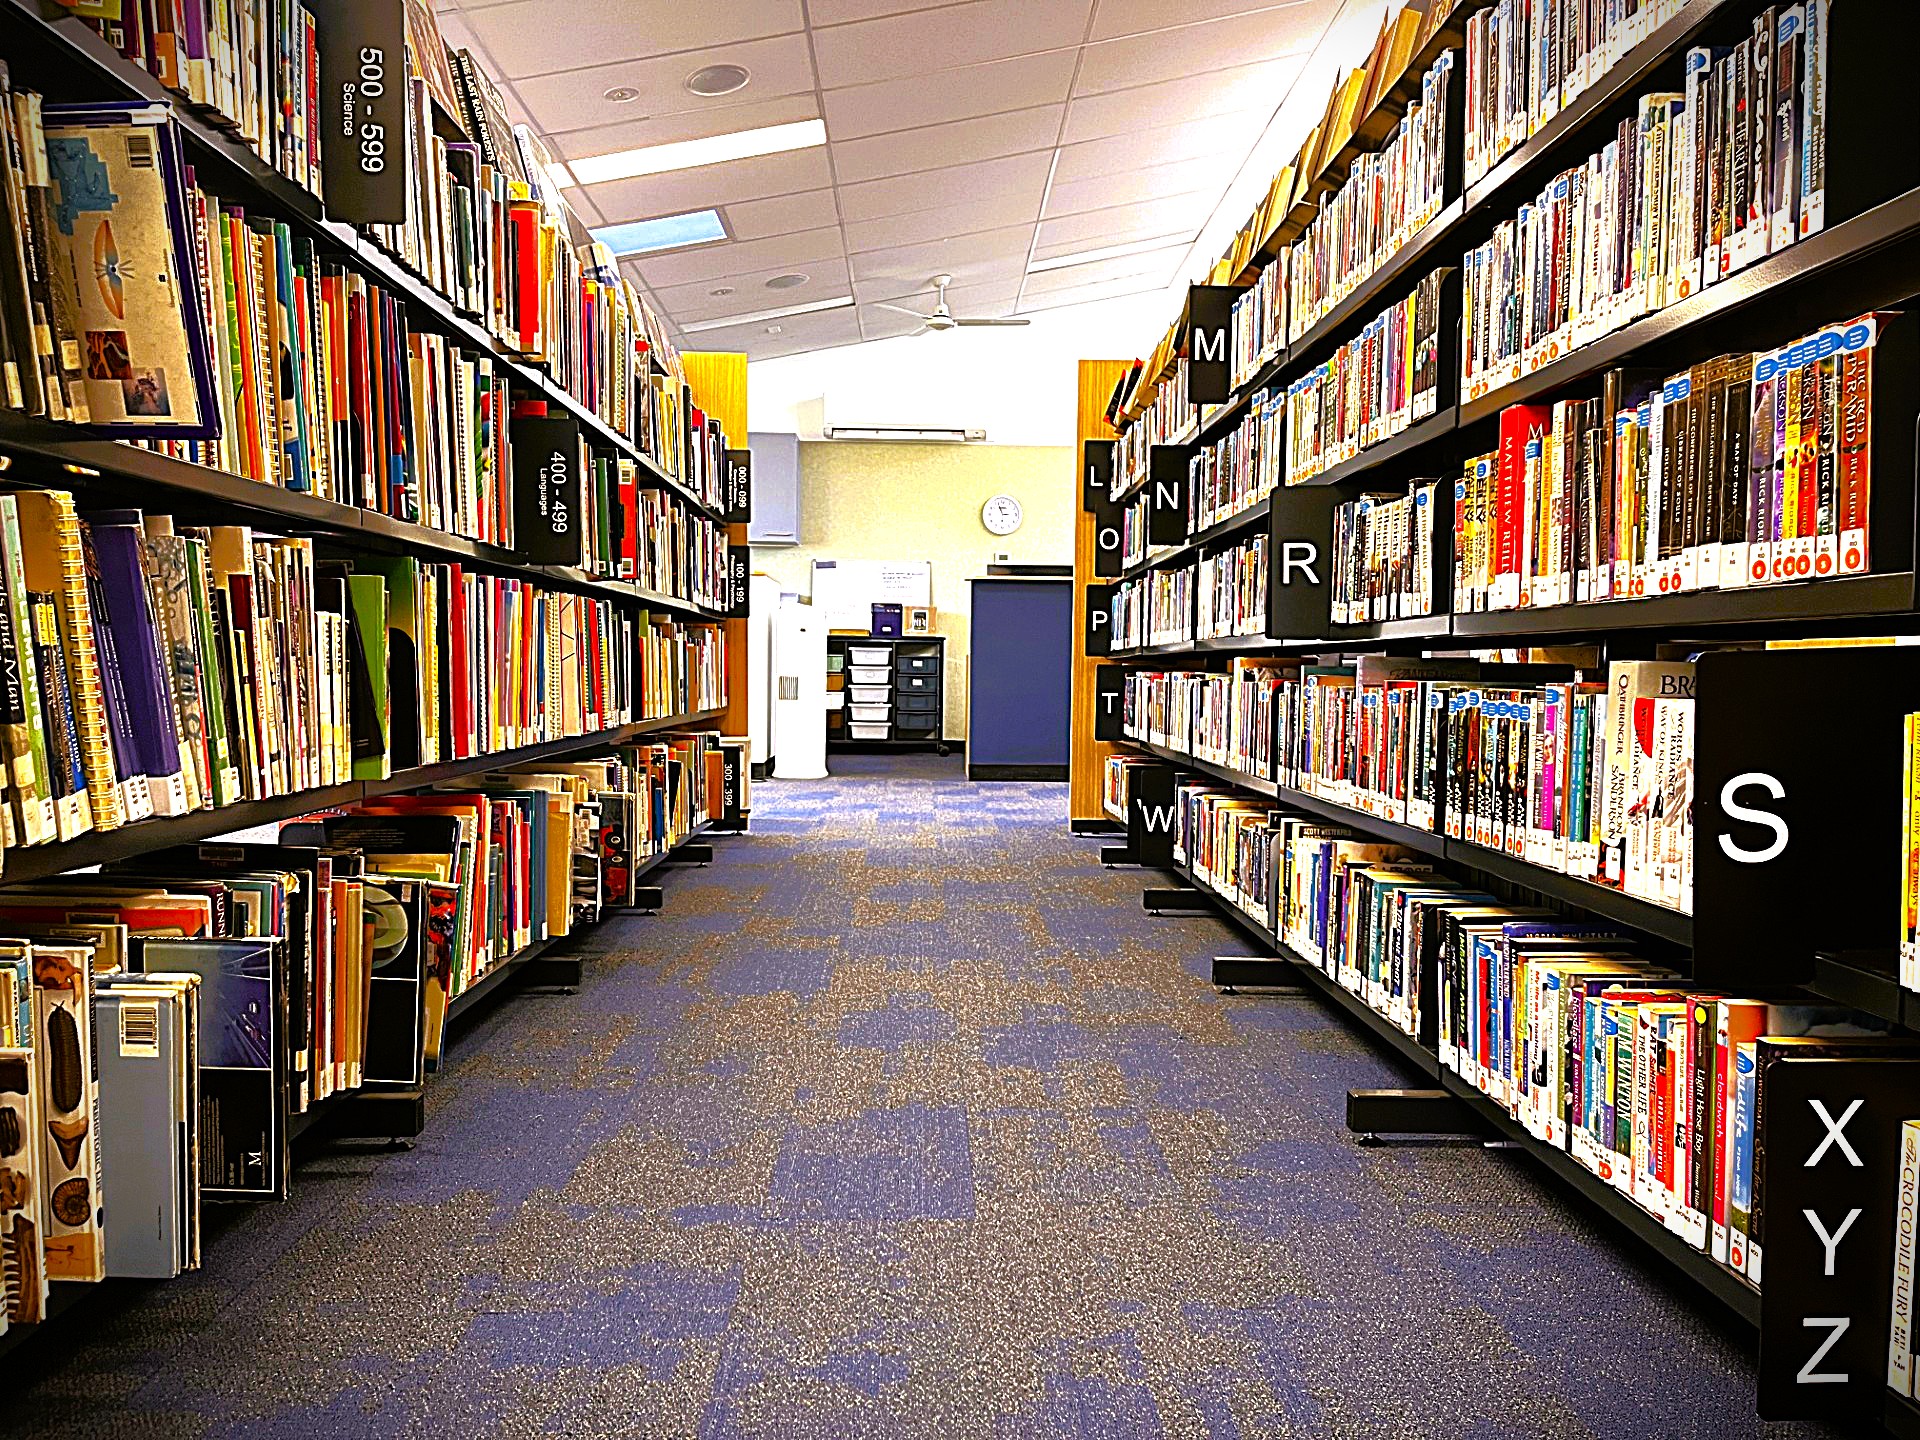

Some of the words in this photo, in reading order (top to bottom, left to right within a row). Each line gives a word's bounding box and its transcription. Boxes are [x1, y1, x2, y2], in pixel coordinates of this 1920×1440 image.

[360, 47, 384, 97] 500
[343, 82, 356, 136] Science
[366, 104, 372, 116] -
[460, 55, 470, 77] THE
[465, 76, 479, 98] LAST
[472, 97, 484, 122] RAIN
[478, 123, 496, 162] FORESTS
[361, 123, 384, 173] 599
[1735, 119, 1749, 206] HEARTLESS
[1651, 189, 1660, 220] SNOWY
[1194, 328, 1225, 362] M
[1821, 374, 1834, 436] JACKSON
[1844, 356, 1859, 443] PYRAMID
[1855, 399, 1866, 434] RED
[551, 451, 567, 485] 400
[1676, 430, 1685, 471] LIBRARY
[1688, 425, 1696, 481] CONFERENCE
[738, 466, 747, 484] 000
[1090, 465, 1104, 487] L
[1503, 436, 1513, 525] MATTHEW
[1676, 474, 1682, 488] OF
[1733, 464, 1739, 478] OF
[1821, 458, 1830, 489] RICK
[538, 467, 548, 516] Languages
[555, 488, 560, 497] -
[738, 490, 747, 508] 099
[1156, 481, 1179, 510] N
[552, 500, 568, 533] 499
[1579, 497, 1590, 562] KINGDOMS
[1099, 527, 1120, 550] O
[736, 562, 745, 578] 100
[1282, 542, 1320, 584] R
[736, 586, 745, 603] 199
[0, 612, 15, 650] and
[1092, 610, 1108, 632] P
[17, 582, 43, 731] ELEMENTS
[4, 658, 20, 711] Man
[1101, 692, 1119, 714] T
[1616, 674, 1628, 755] OATHBRINGER
[1659, 705, 1668, 731] WAY
[1675, 711, 1685, 762] WORDS
[724, 763, 733, 781] 300
[1658, 749, 1666, 785] KINGS
[1667, 734, 1677, 800] RADIANCE
[724, 788, 733, 806] 399
[1608, 765, 1619, 840] SANDERSON
[1616, 773, 1626, 835] BRANDON
[1142, 805, 1175, 833] W
[1718, 772, 1789, 863] S
[1911, 862, 1920, 907] always
[1533, 970, 1540, 985] My
[1572, 996, 1581, 1050] bloodlace
[1618, 1020, 1633, 1053] TIM
[1638, 1034, 1646, 1053] THE
[1638, 1055, 1647, 1087] OTHER
[1695, 1068, 1706, 1096] Light
[1617, 1056, 1632, 1122] WINTON
[1637, 1090, 1648, 1114] LIFE
[1716, 1073, 1724, 1138] cloudwish
[1695, 1098, 1705, 1132] Horse
[92, 1098, 101, 1170] PREHISTORIC
[1693, 1132, 1704, 1155] Boy
[1803, 1099, 1865, 1167] X
[248, 1150, 262, 1166] M
[1753, 1138, 1766, 1172] Seven
[1905, 1137, 1917, 1167] The
[1752, 1172, 1762, 1189] for
[1752, 1199, 1765, 1236] Secret
[1898, 1167, 1915, 1275] CROCODILE
[1802, 1208, 1863, 1276] Y
[1895, 1275, 1910, 1325] FURY
[1796, 1317, 1850, 1384] Z
